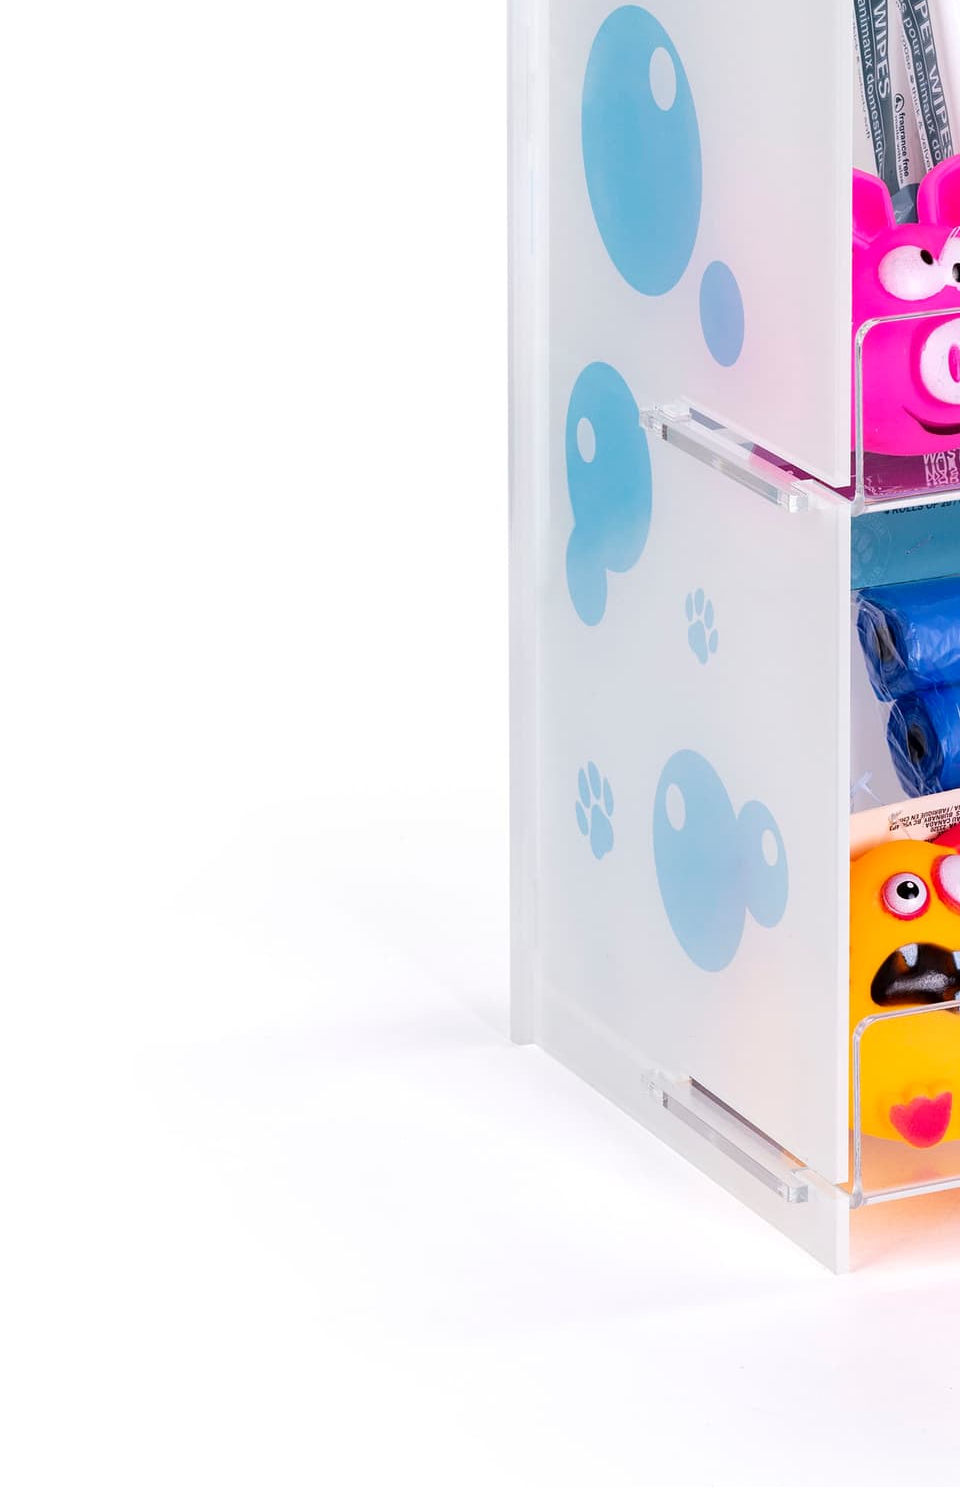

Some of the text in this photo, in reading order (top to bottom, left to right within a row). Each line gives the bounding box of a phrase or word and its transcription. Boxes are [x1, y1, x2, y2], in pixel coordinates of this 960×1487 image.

[866, 73, 884, 167] domestiqu
[904, 17, 921, 57] pour
[916, 62, 936, 134] animaux
[913, 0, 935, 57] PET
[928, 64, 954, 159] WIPES
[899, 112, 908, 157] fragrance
